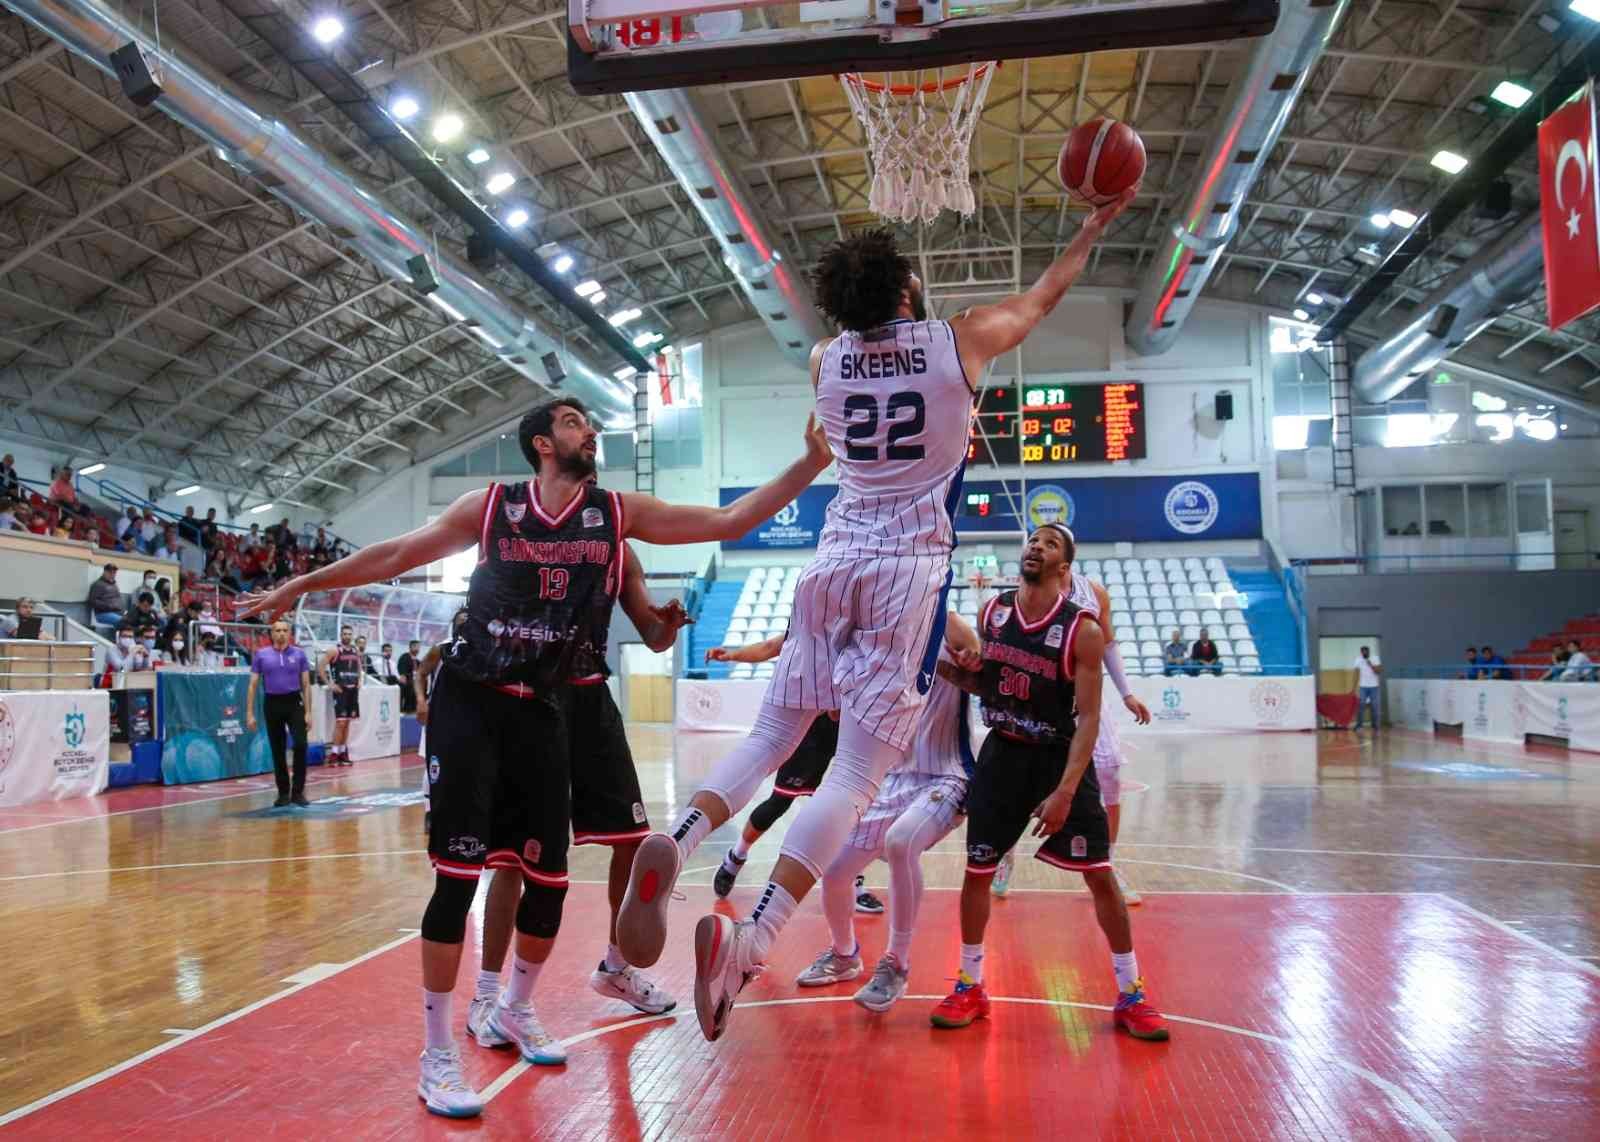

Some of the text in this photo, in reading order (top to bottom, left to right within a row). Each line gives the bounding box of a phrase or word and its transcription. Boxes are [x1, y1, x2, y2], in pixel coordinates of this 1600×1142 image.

[840, 347, 928, 380] SKEENS
[843, 391, 926, 461] 22
[1053, 417, 1073, 434] 02
[538, 567, 570, 601] 13
[998, 666, 1031, 701] 30
